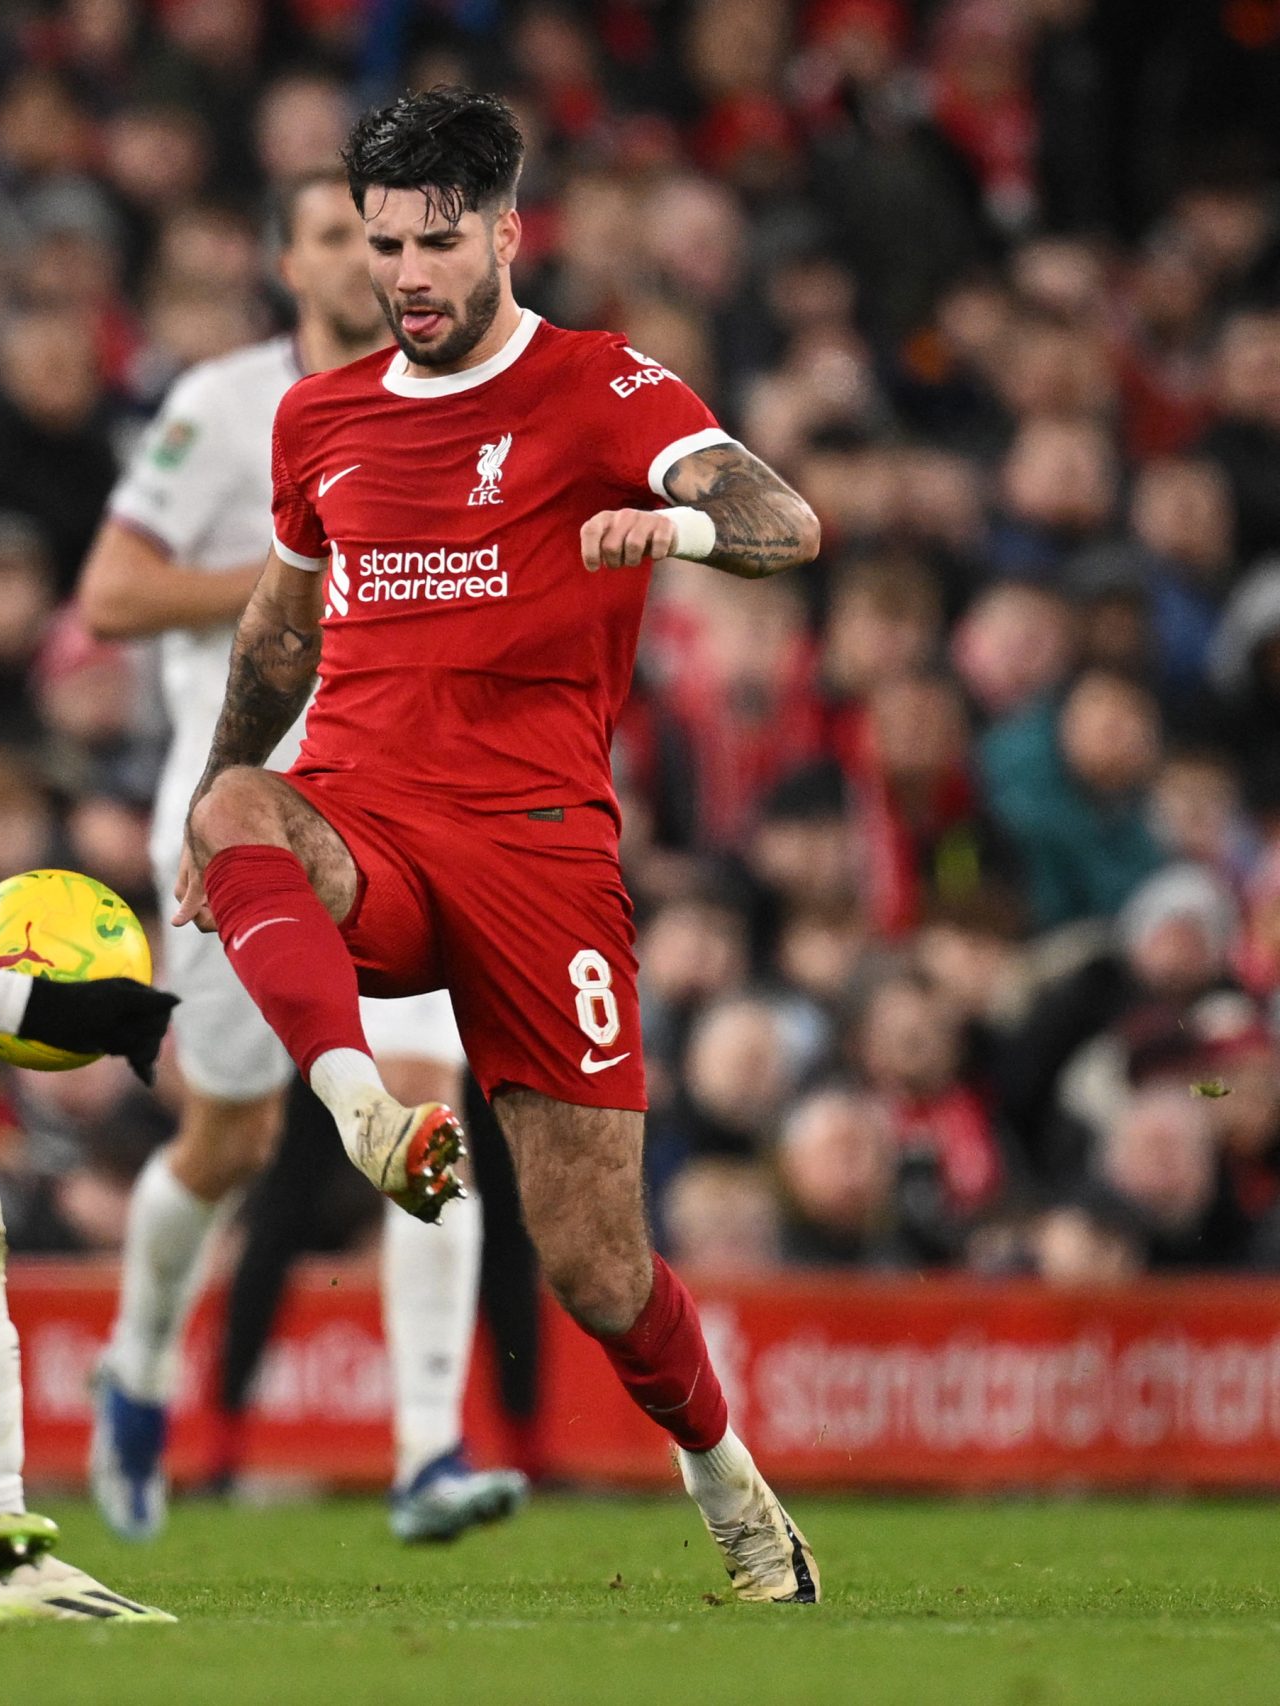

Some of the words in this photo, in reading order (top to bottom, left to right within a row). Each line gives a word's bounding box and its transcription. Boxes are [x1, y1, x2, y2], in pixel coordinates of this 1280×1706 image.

[359, 543, 499, 577] standard
[357, 570, 508, 603] chartered
[568, 949, 620, 1047] 8
